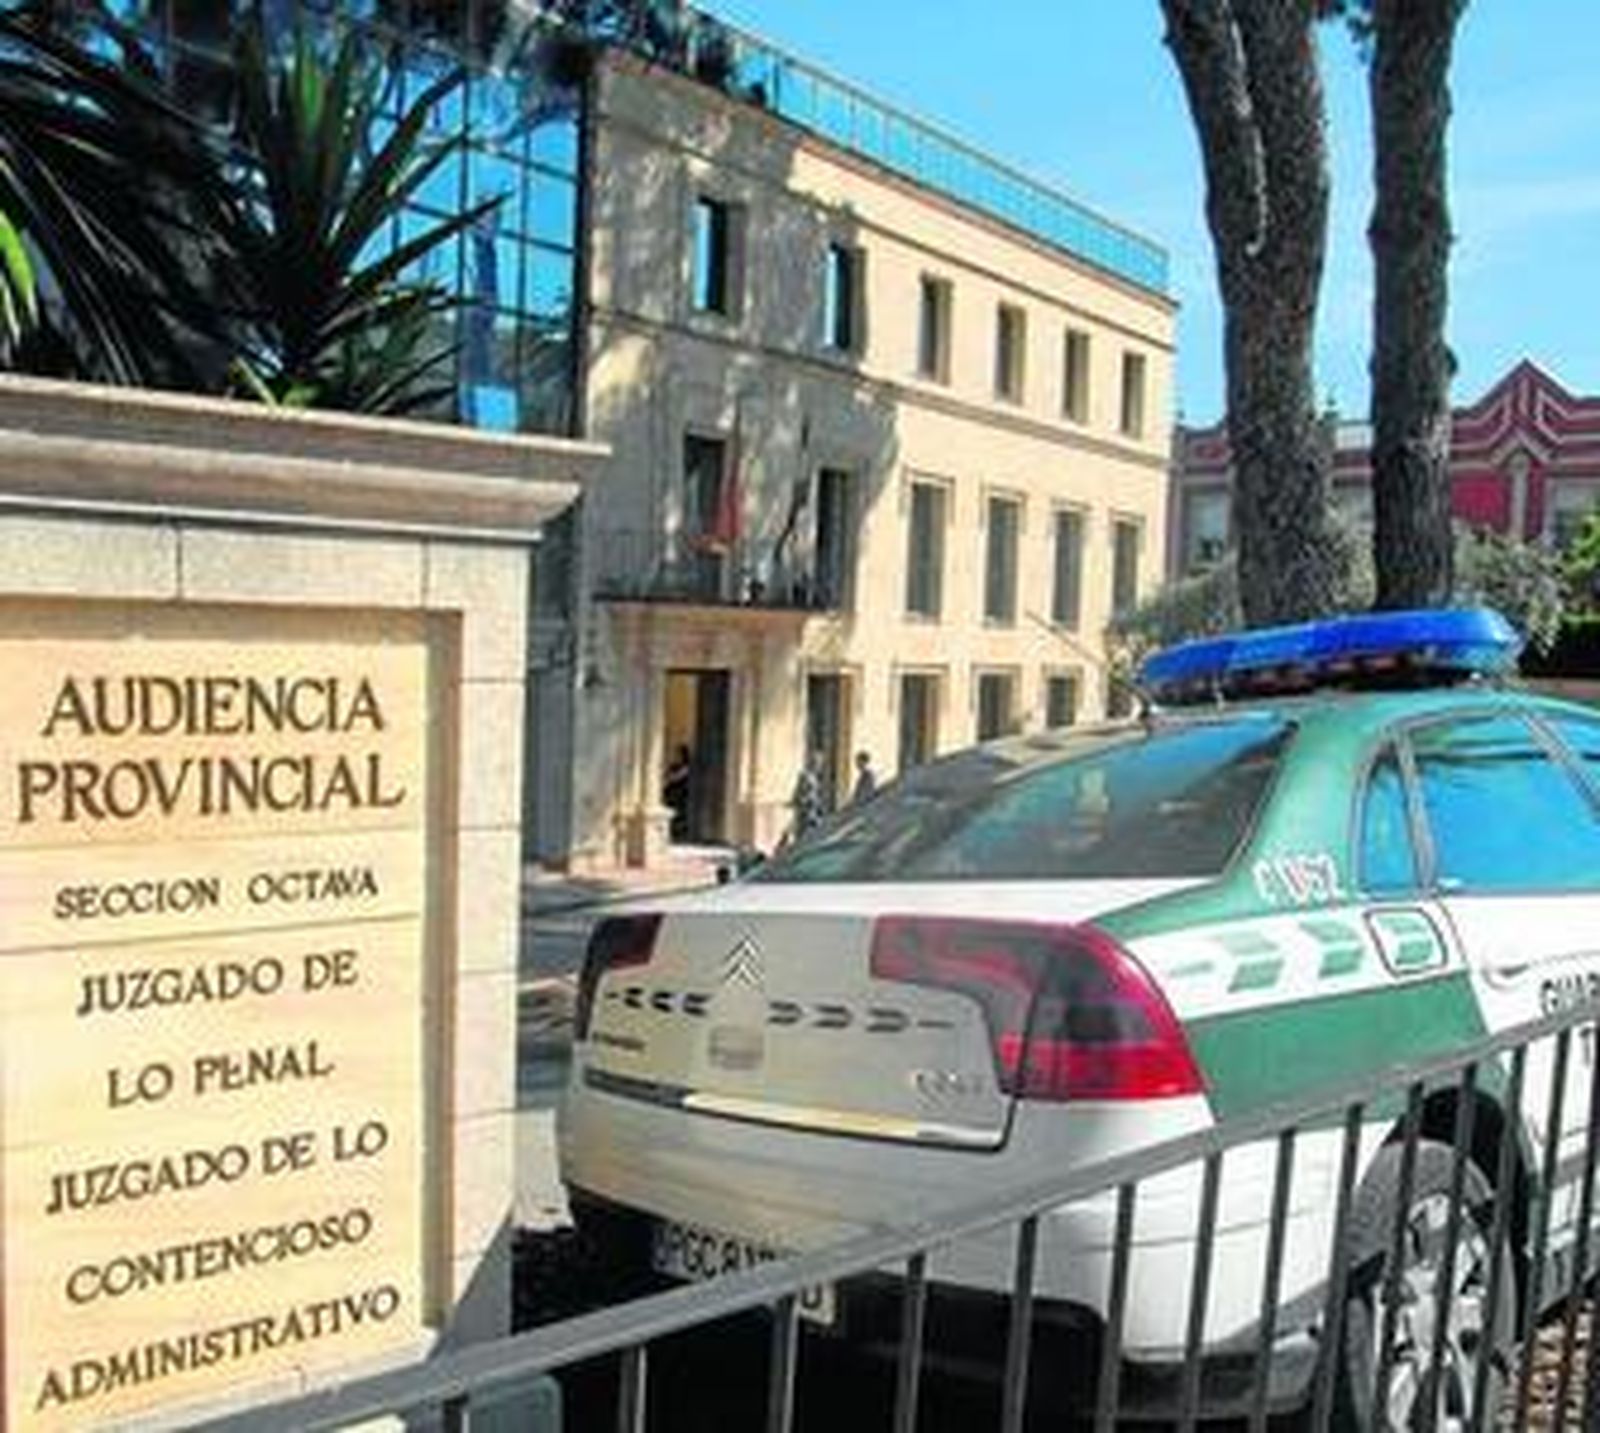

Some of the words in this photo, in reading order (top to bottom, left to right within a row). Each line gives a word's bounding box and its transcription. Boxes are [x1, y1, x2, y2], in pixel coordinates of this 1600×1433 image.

[40, 676, 386, 738] AUDIENCIA
[17, 752, 406, 824] PROVINCIAL
[53, 877, 220, 920] SECCION
[247, 867, 379, 905] OCTAVA
[76, 957, 285, 1018] JUZGADO
[302, 949, 359, 993] DE
[107, 1062, 175, 1109] LO
[193, 1040, 335, 1096] PENAL
[45, 1144, 251, 1216] JUZGADO
[261, 1131, 316, 1175] DE
[333, 1121, 389, 1162] LO
[65, 1207, 372, 1304] CONTENCIOSO
[35, 1284, 401, 1410] ADMINISTRATIVO
